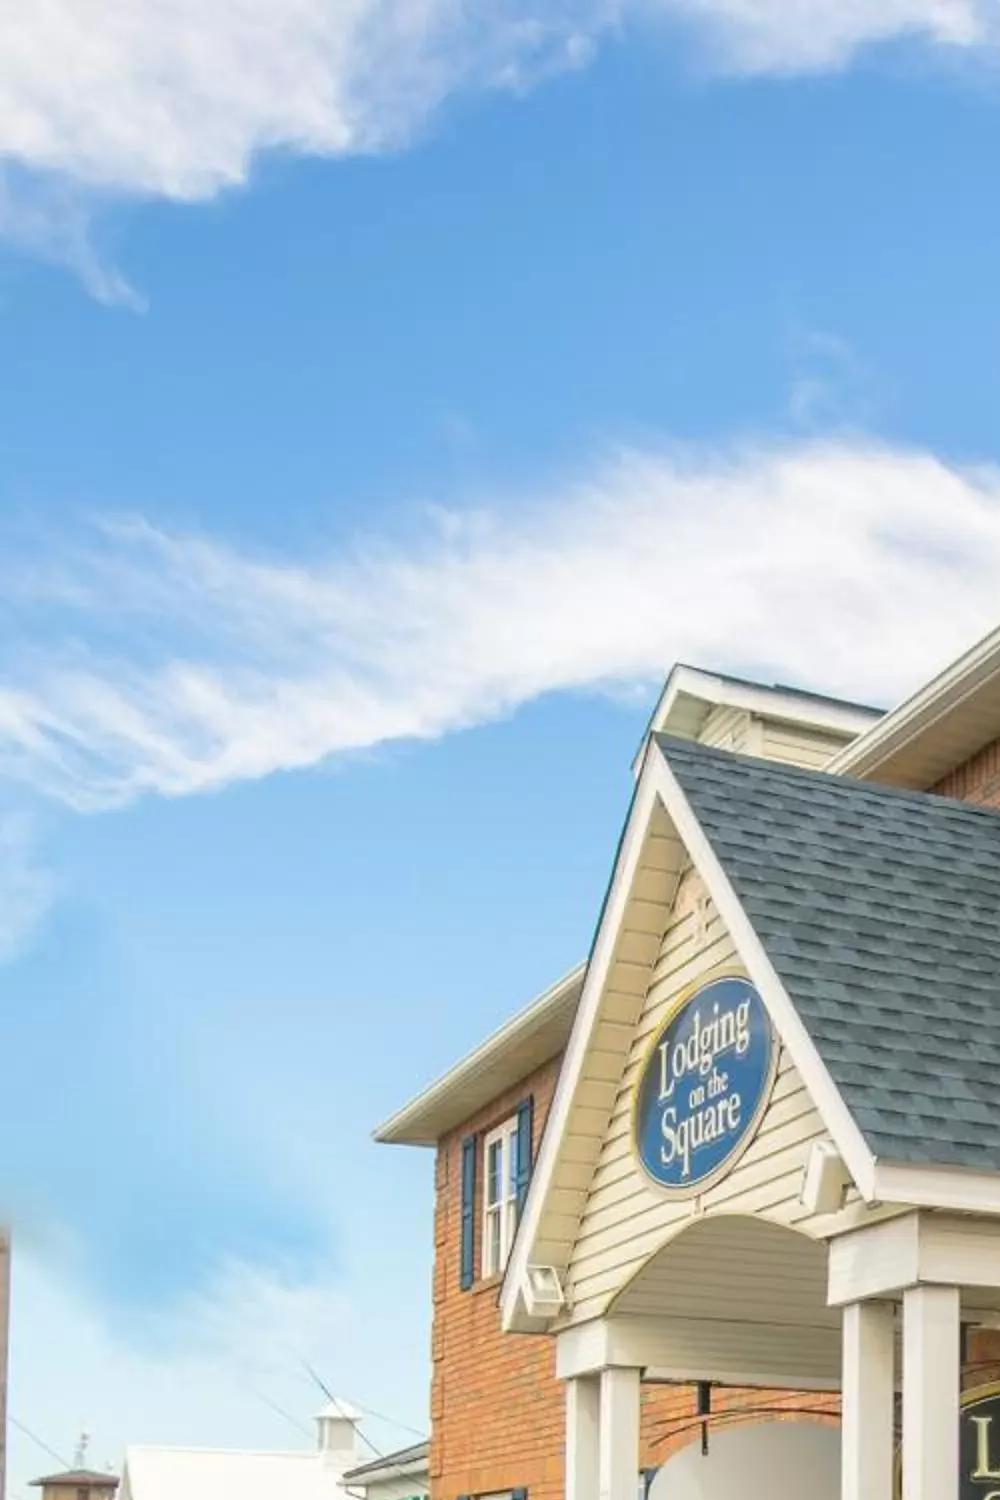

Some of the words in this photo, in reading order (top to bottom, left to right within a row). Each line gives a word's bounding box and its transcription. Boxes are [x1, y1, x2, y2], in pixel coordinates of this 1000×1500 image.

[658, 998, 750, 1100] Lodging
[689, 1087, 705, 1109] on
[707, 1067, 729, 1099] the
[661, 1092, 741, 1177] Square
